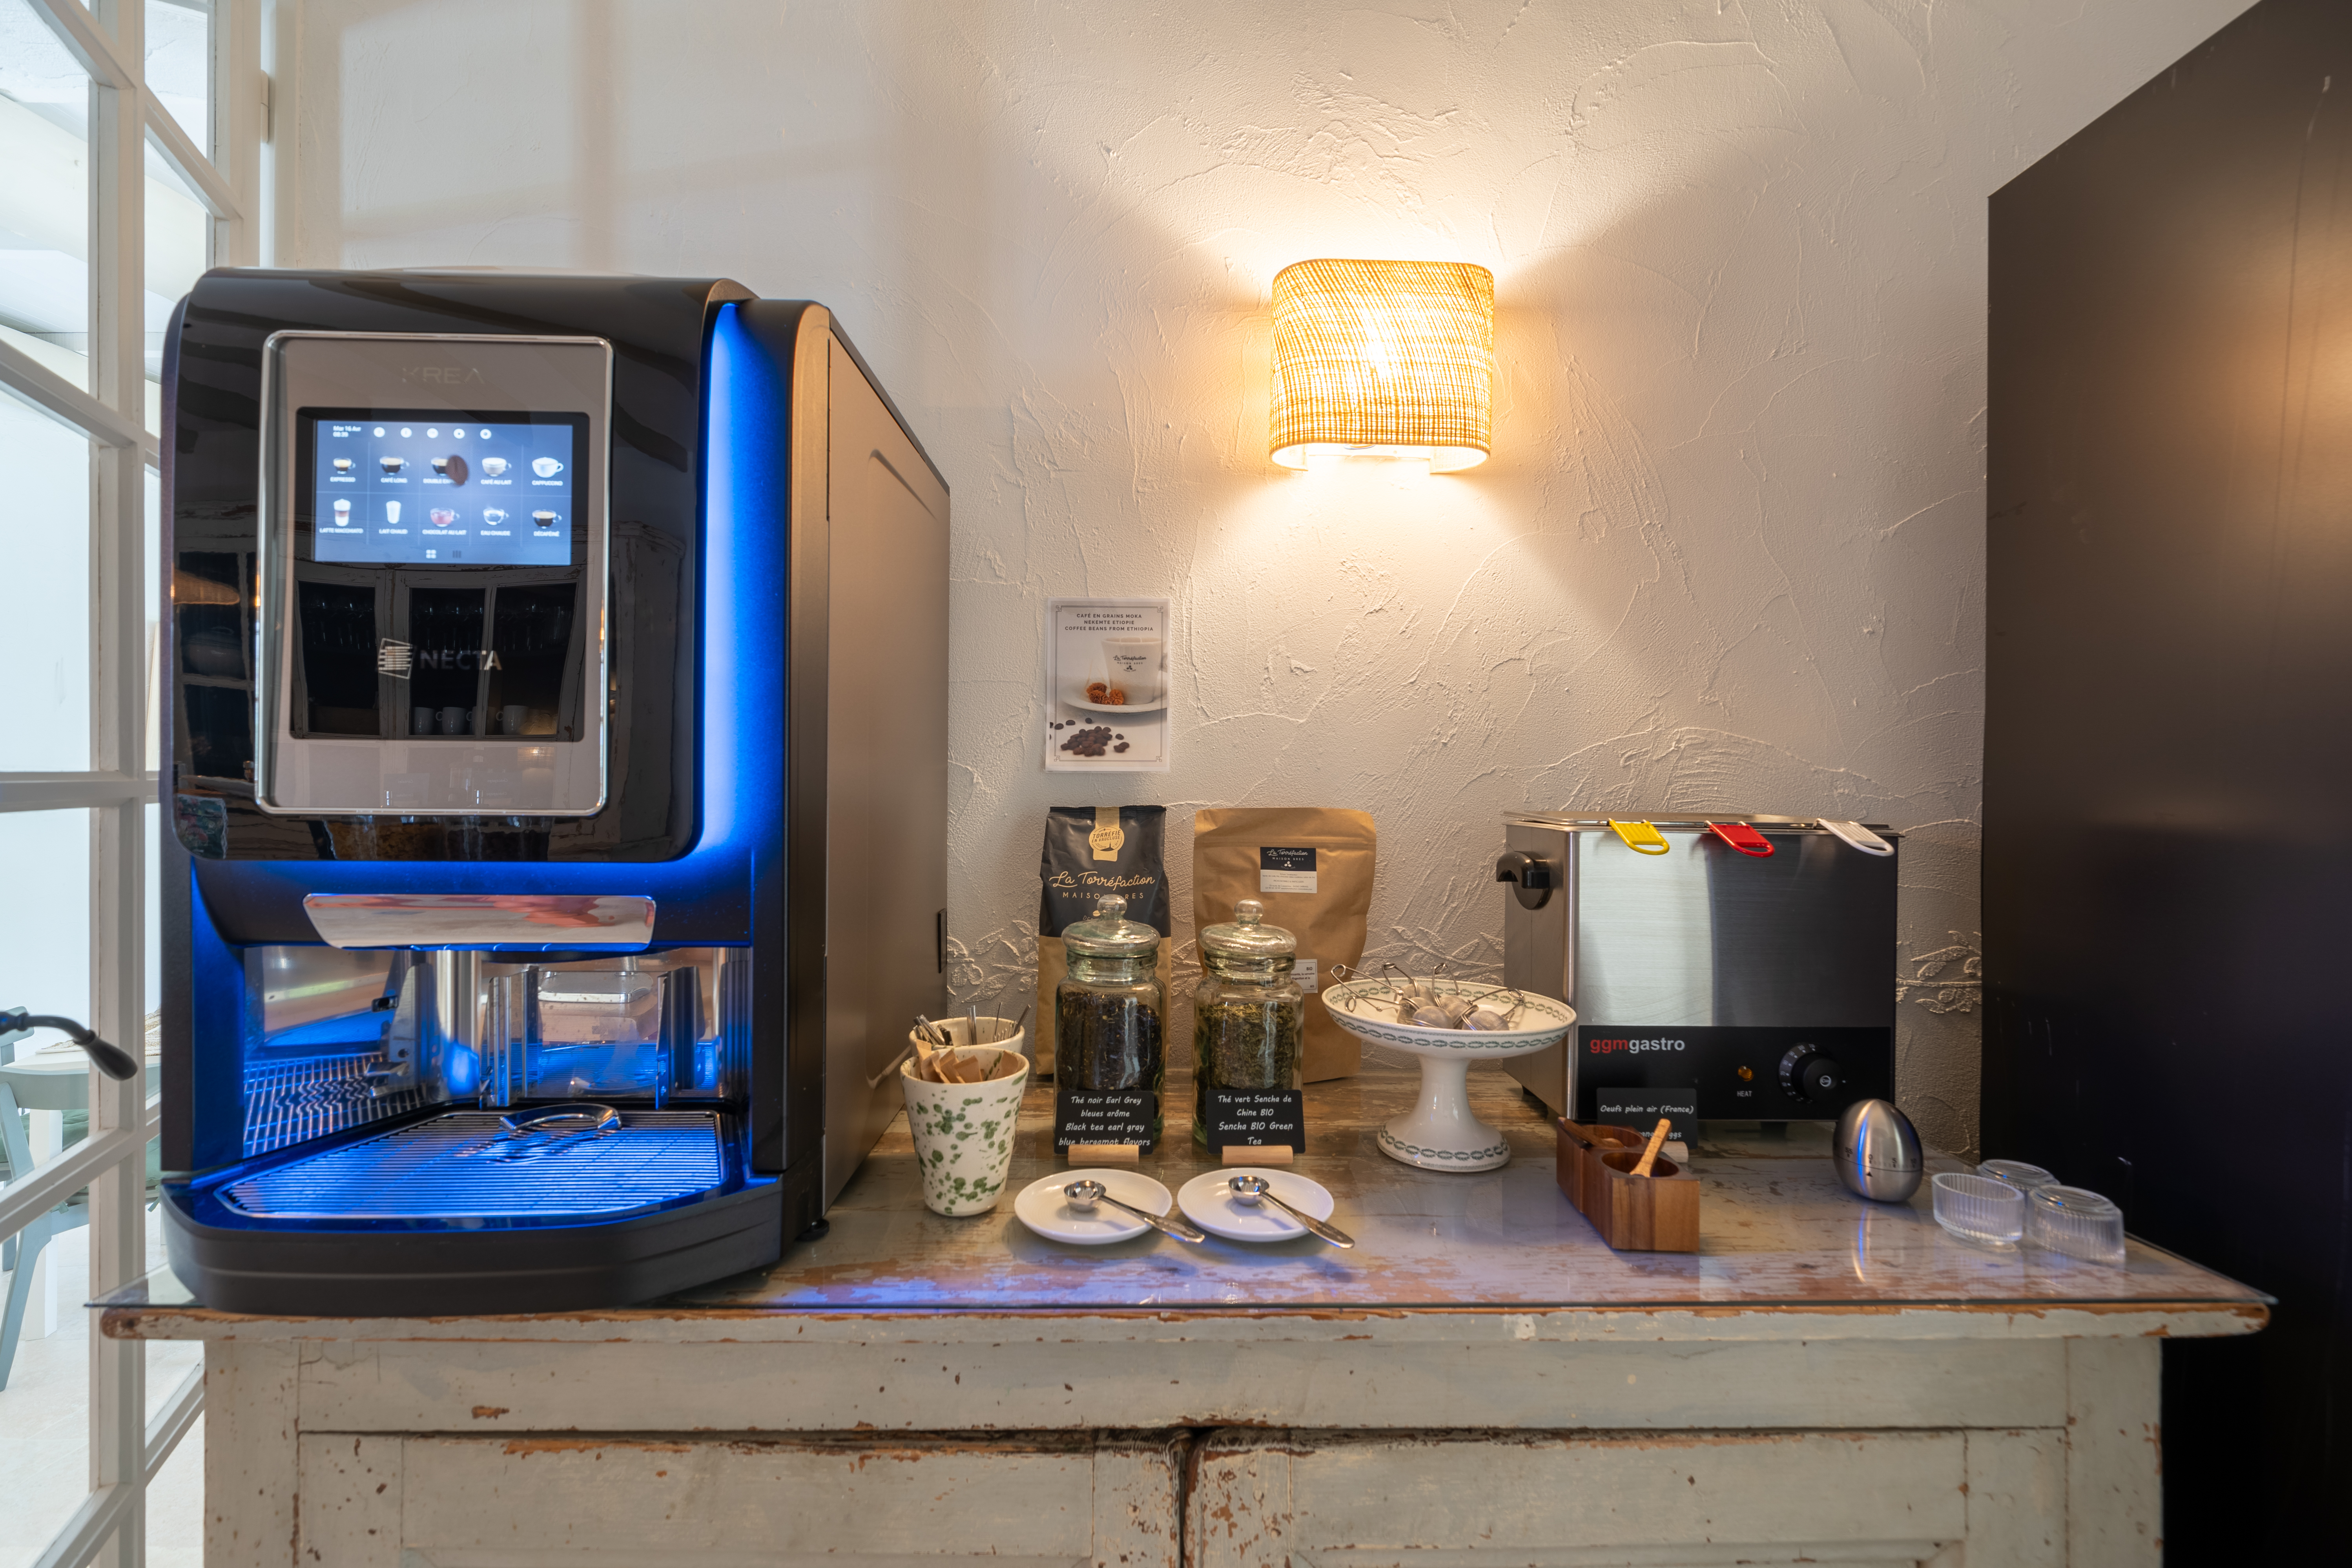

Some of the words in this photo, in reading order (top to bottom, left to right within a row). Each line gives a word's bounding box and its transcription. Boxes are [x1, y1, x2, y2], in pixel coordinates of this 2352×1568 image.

[402, 367, 484, 384] KREA
[420, 650, 502, 670] NECTA
[1093, 829, 1121, 839] TORRÉFIÉ
[1049, 871, 1078, 888] La
[1078, 871, 1155, 891] Torréfaction
[1590, 1037, 1685, 1054] ggmgastro
[1124, 1096, 1141, 1105] Grey
[1625, 1105, 1643, 1114] plein
[1660, 1105, 1694, 1114] (France)
[1065, 1122, 1087, 1131] Black
[1108, 1122, 1124, 1131] earl
[1127, 1125, 1145, 1133] gray
[1219, 1121, 1247, 1130] Sencha
[1251, 1122, 1265, 1130] BIO
[1269, 1121, 1293, 1130] Green
[1059, 1137, 1076, 1145] blue
[1123, 1137, 1150, 1146] flavors
[1247, 1136, 1262, 1145] Tea
